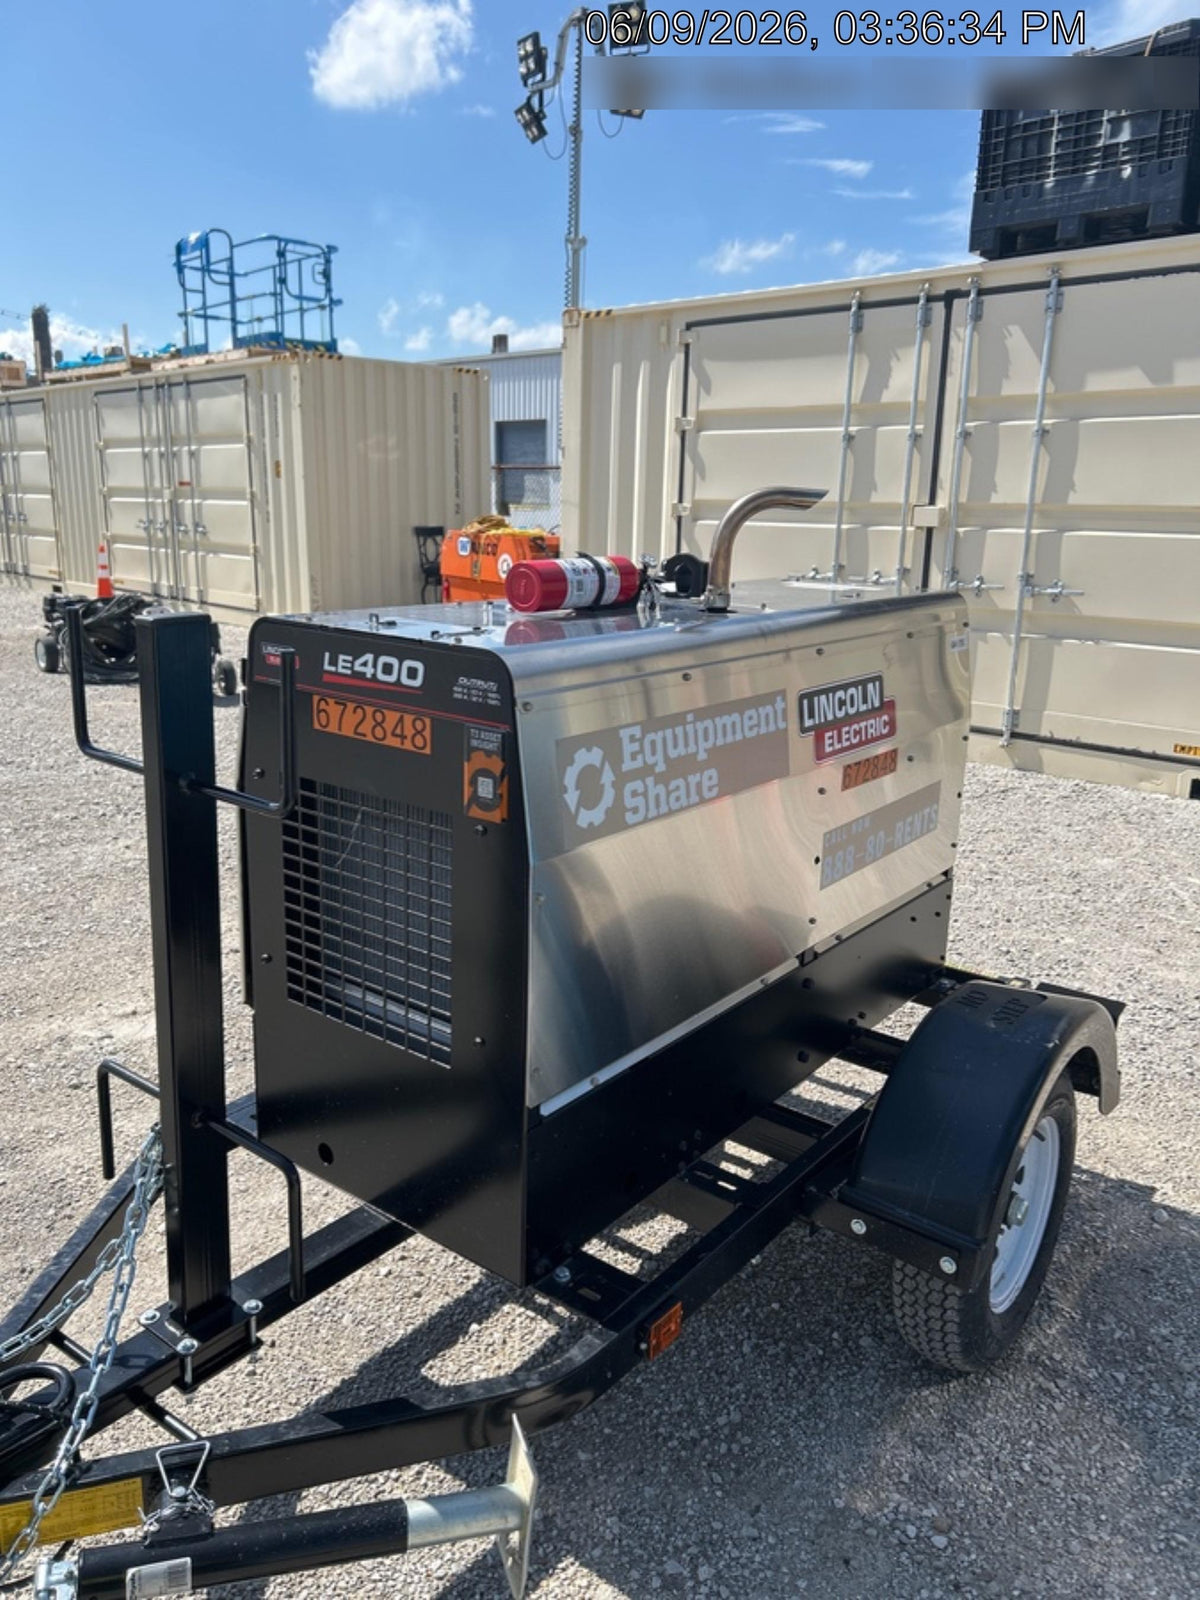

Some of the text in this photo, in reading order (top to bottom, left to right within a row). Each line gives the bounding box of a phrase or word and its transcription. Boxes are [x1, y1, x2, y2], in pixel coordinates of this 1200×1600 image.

[322, 651, 425, 688] LE400
[315, 697, 428, 752] 672848
[803, 680, 880, 728] LINCOLN
[619, 695, 787, 773] Equipment
[824, 714, 890, 754] ELECTRIC
[843, 751, 897, 790] 672848
[623, 767, 719, 826] Share
